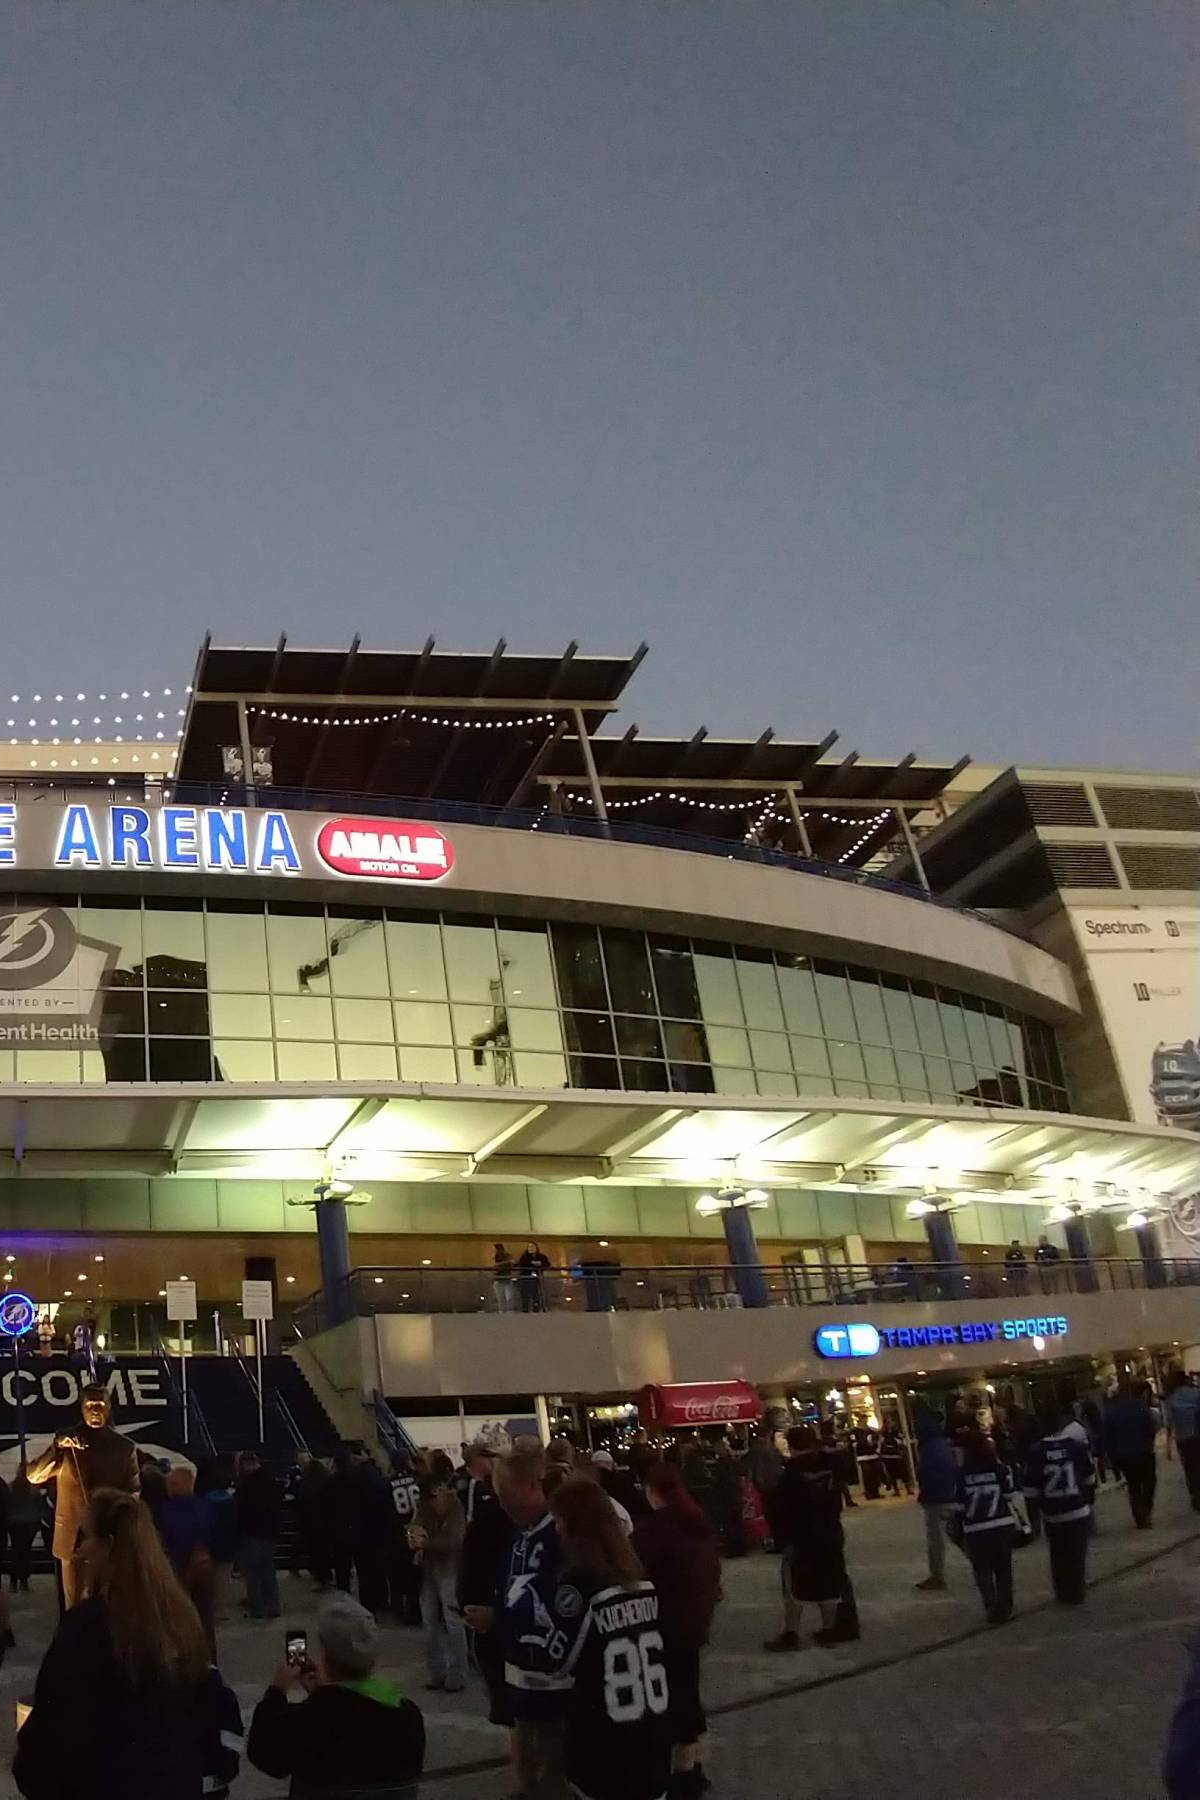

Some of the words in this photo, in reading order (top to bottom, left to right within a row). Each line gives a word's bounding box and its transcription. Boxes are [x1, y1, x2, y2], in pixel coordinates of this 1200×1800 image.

[55, 804, 303, 872] ARENA
[329, 831, 448, 869] AMALIE
[359, 860, 400, 873] MOTOR
[400, 863, 421, 875] OIL
[1084, 919, 1147, 938] Spectrum
[45, 998, 60, 1007] BY
[1133, 982, 1150, 1001] 10
[882, 1325, 958, 1348] TAMPA
[958, 1321, 999, 1344] BAY
[1003, 1316, 1068, 1340] SPORTS
[1043, 1461, 1080, 1498] 21
[965, 1483, 1000, 1519] 77
[593, 1595, 659, 1634] KUCHEROV
[603, 1629, 669, 1724] 86
